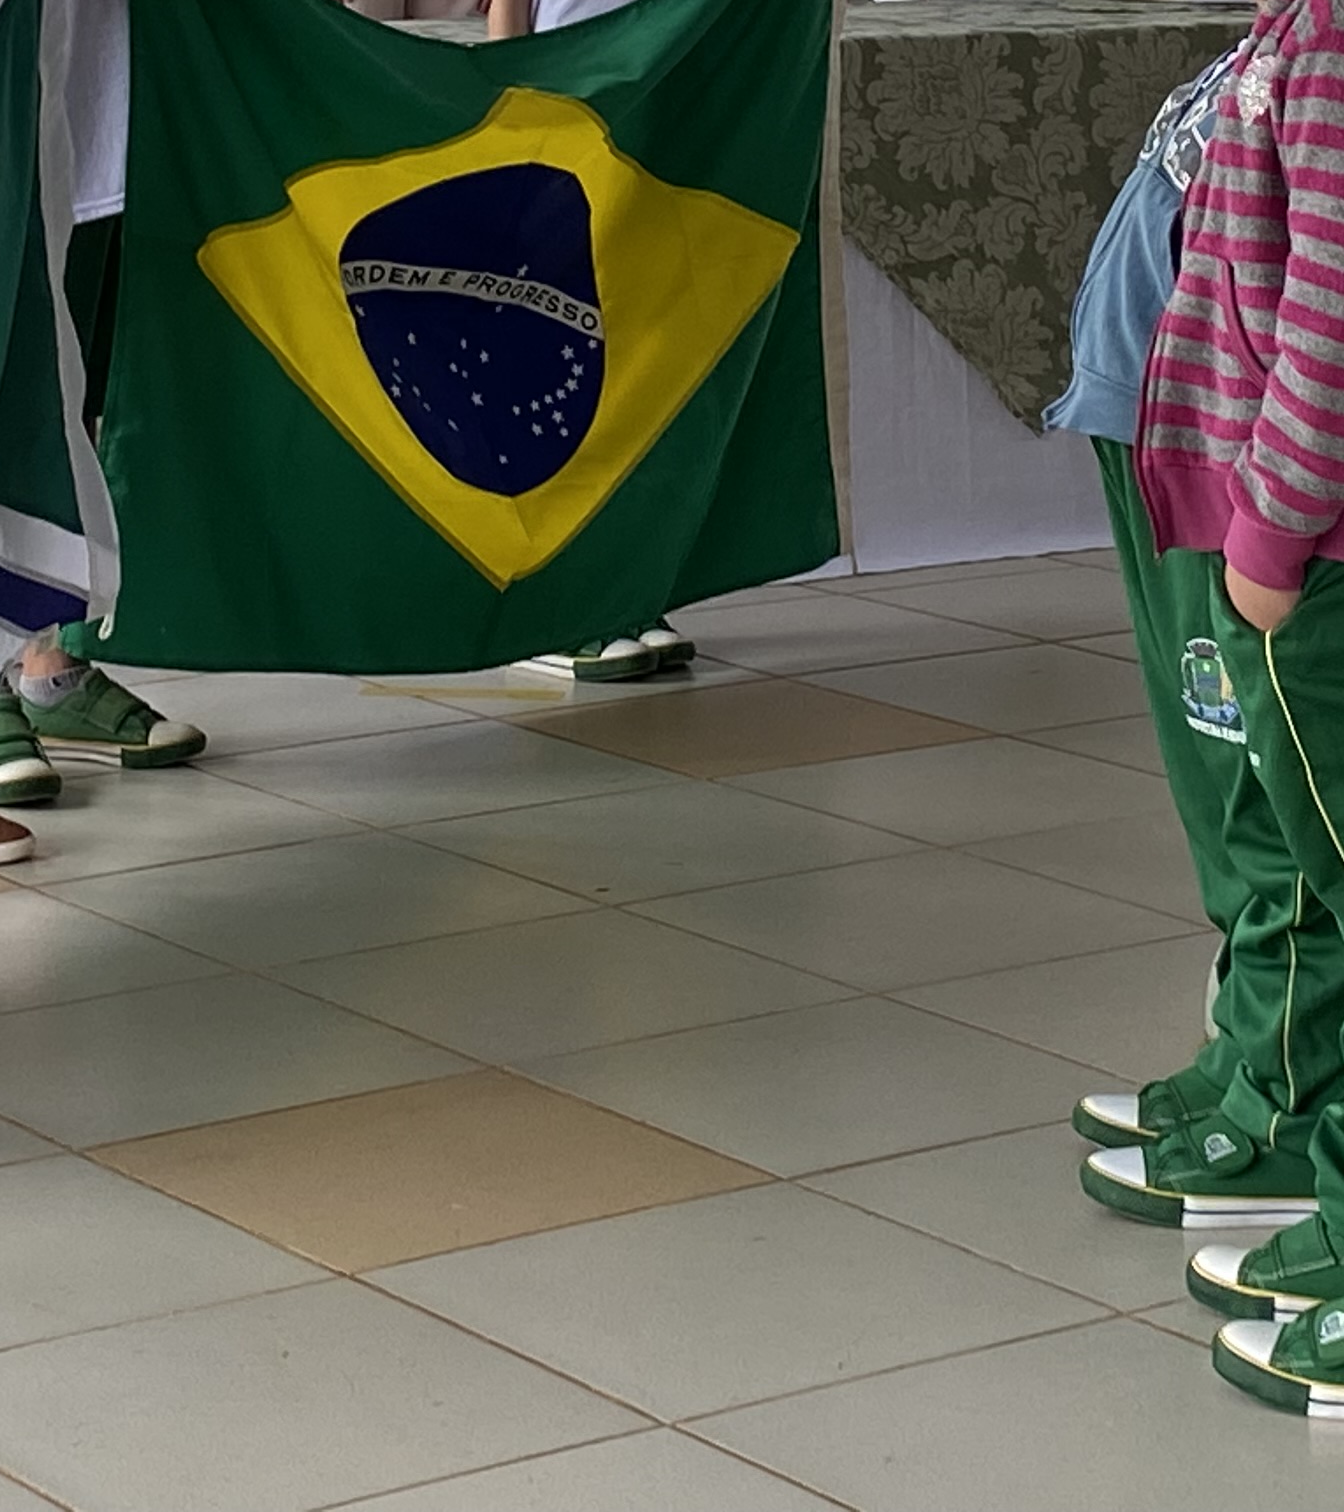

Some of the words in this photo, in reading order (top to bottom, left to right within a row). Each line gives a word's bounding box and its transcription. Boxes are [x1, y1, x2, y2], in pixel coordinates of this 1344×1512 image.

[343, 263, 432, 287] ORDEM
[438, 271, 457, 286] E
[463, 273, 599, 332] PROGRESSO
